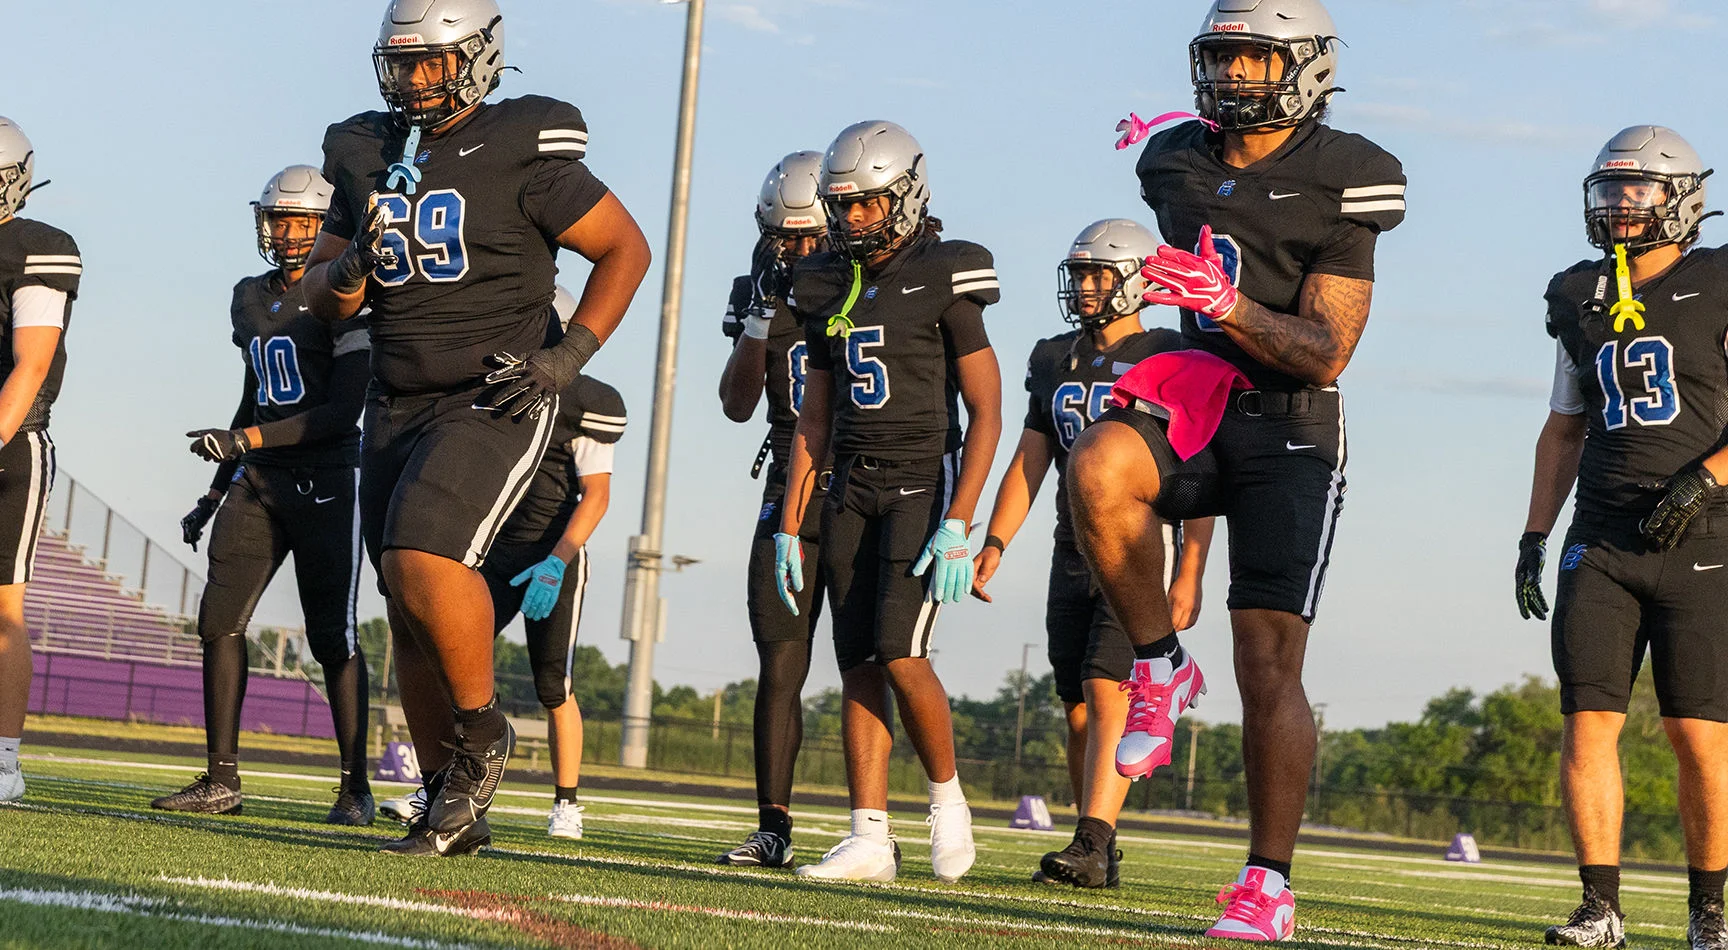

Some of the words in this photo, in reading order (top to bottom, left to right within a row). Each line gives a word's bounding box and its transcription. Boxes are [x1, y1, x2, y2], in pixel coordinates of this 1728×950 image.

[389, 36, 419, 45] Riddell
[1212, 23, 1245, 32] Riddell
[828, 184, 853, 192] Riddell
[371, 188, 470, 287] 69
[249, 335, 306, 406] 10
[845, 325, 891, 409] 5
[1594, 335, 1681, 431] 13
